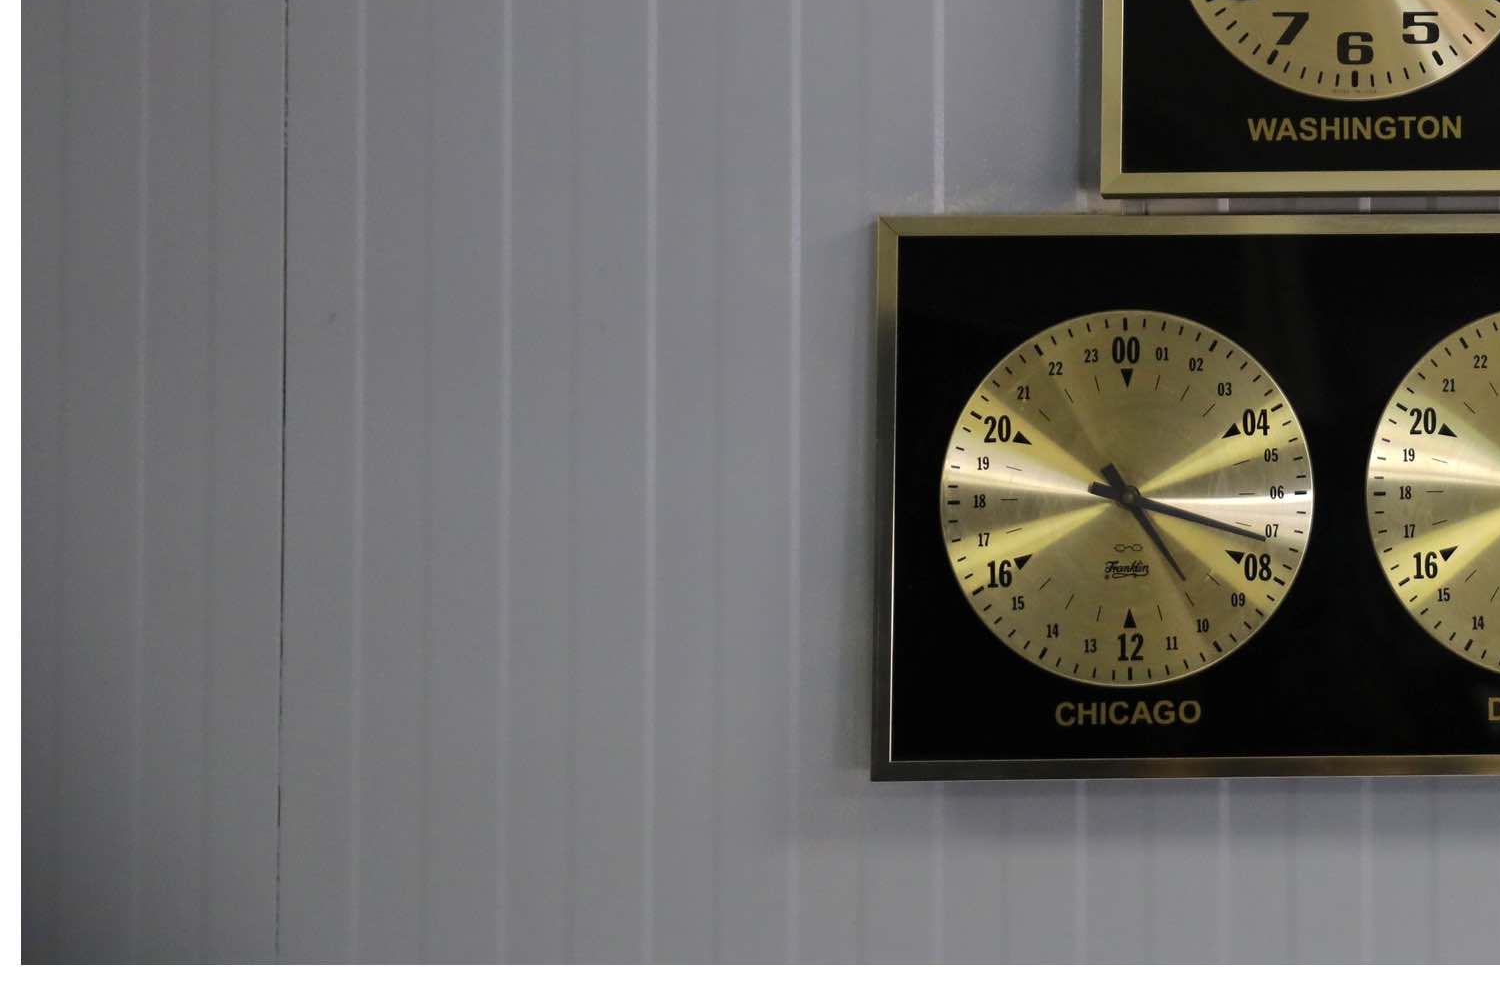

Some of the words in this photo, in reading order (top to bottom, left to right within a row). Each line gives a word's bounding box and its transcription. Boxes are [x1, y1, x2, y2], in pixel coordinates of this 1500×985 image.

[1273, 12, 1309, 45] 7
[1402, 12, 1439, 44] 5
[1337, 32, 1373, 65] 6
[1248, 116, 1461, 140] WASHINGTON
[1112, 337, 1140, 364] 00
[984, 415, 1011, 442] 20
[1243, 409, 1269, 435] 04
[1410, 407, 1436, 434] 20
[974, 494, 986, 508] 18
[988, 560, 1012, 588] 16
[1104, 560, 1150, 579] Franklin
[1245, 554, 1271, 581] 08
[1414, 552, 1437, 579] 16
[1118, 634, 1143, 661] 12
[1056, 701, 1201, 725] CHICAGO
